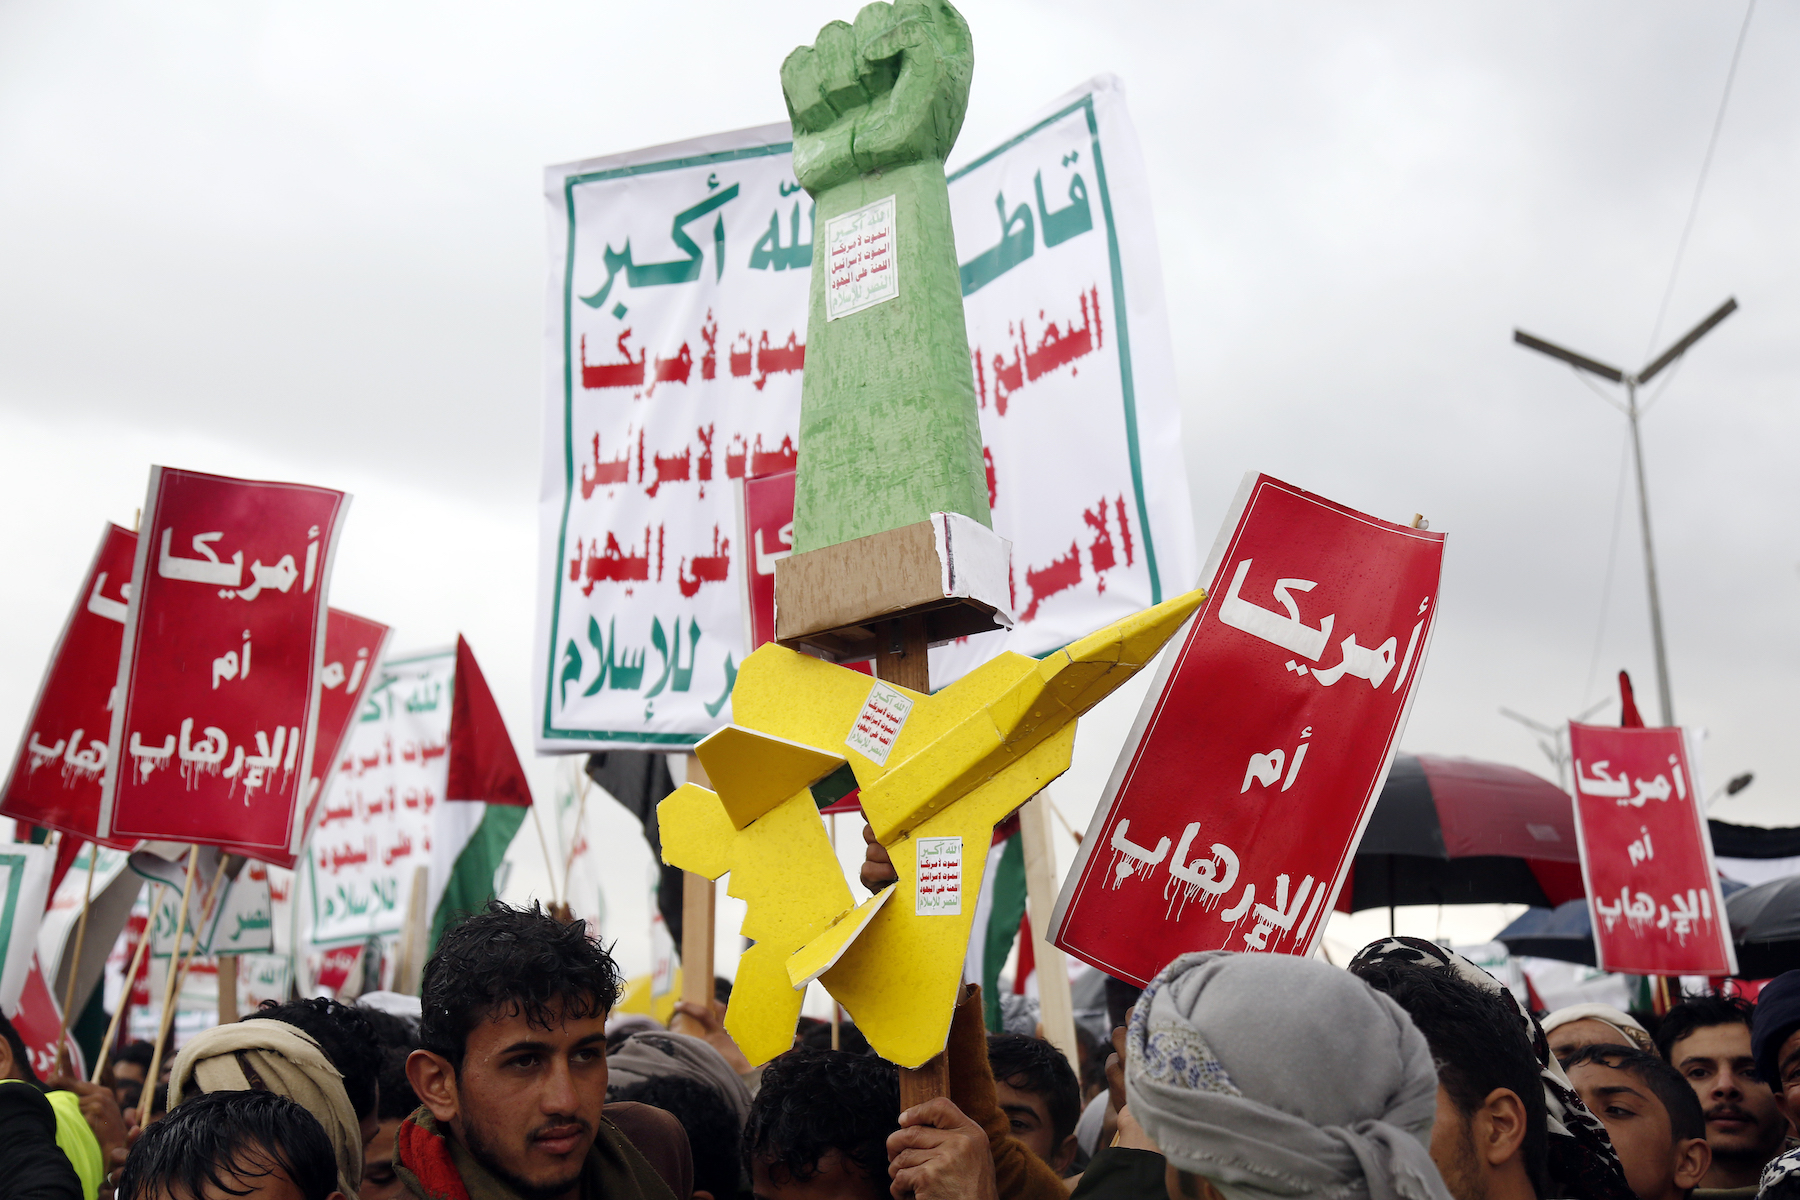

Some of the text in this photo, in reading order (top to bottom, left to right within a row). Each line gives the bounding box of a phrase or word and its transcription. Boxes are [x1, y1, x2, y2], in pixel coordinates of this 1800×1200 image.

[578, 172, 816, 321] لله أكبر
[959, 149, 1093, 297] قاط
[580, 306, 806, 401] موت لأمريكا
[580, 421, 715, 501] لإسرائيل
[158, 524, 320, 601] أمريكا
[568, 520, 665, 599] اليهود
[677, 520, 731, 599] على
[212, 629, 252, 691] أم
[1218, 557, 1430, 695] أمريكا
[560, 613, 702, 724] للإسلام
[129, 717, 300, 798] الإرهاب
[1240, 725, 1314, 795] أم
[1575, 753, 1687, 808] أمريكا
[1104, 817, 1328, 954] الإرهاب
[1627, 825, 1655, 868] أم
[1595, 885, 1713, 940] الإرهاب
